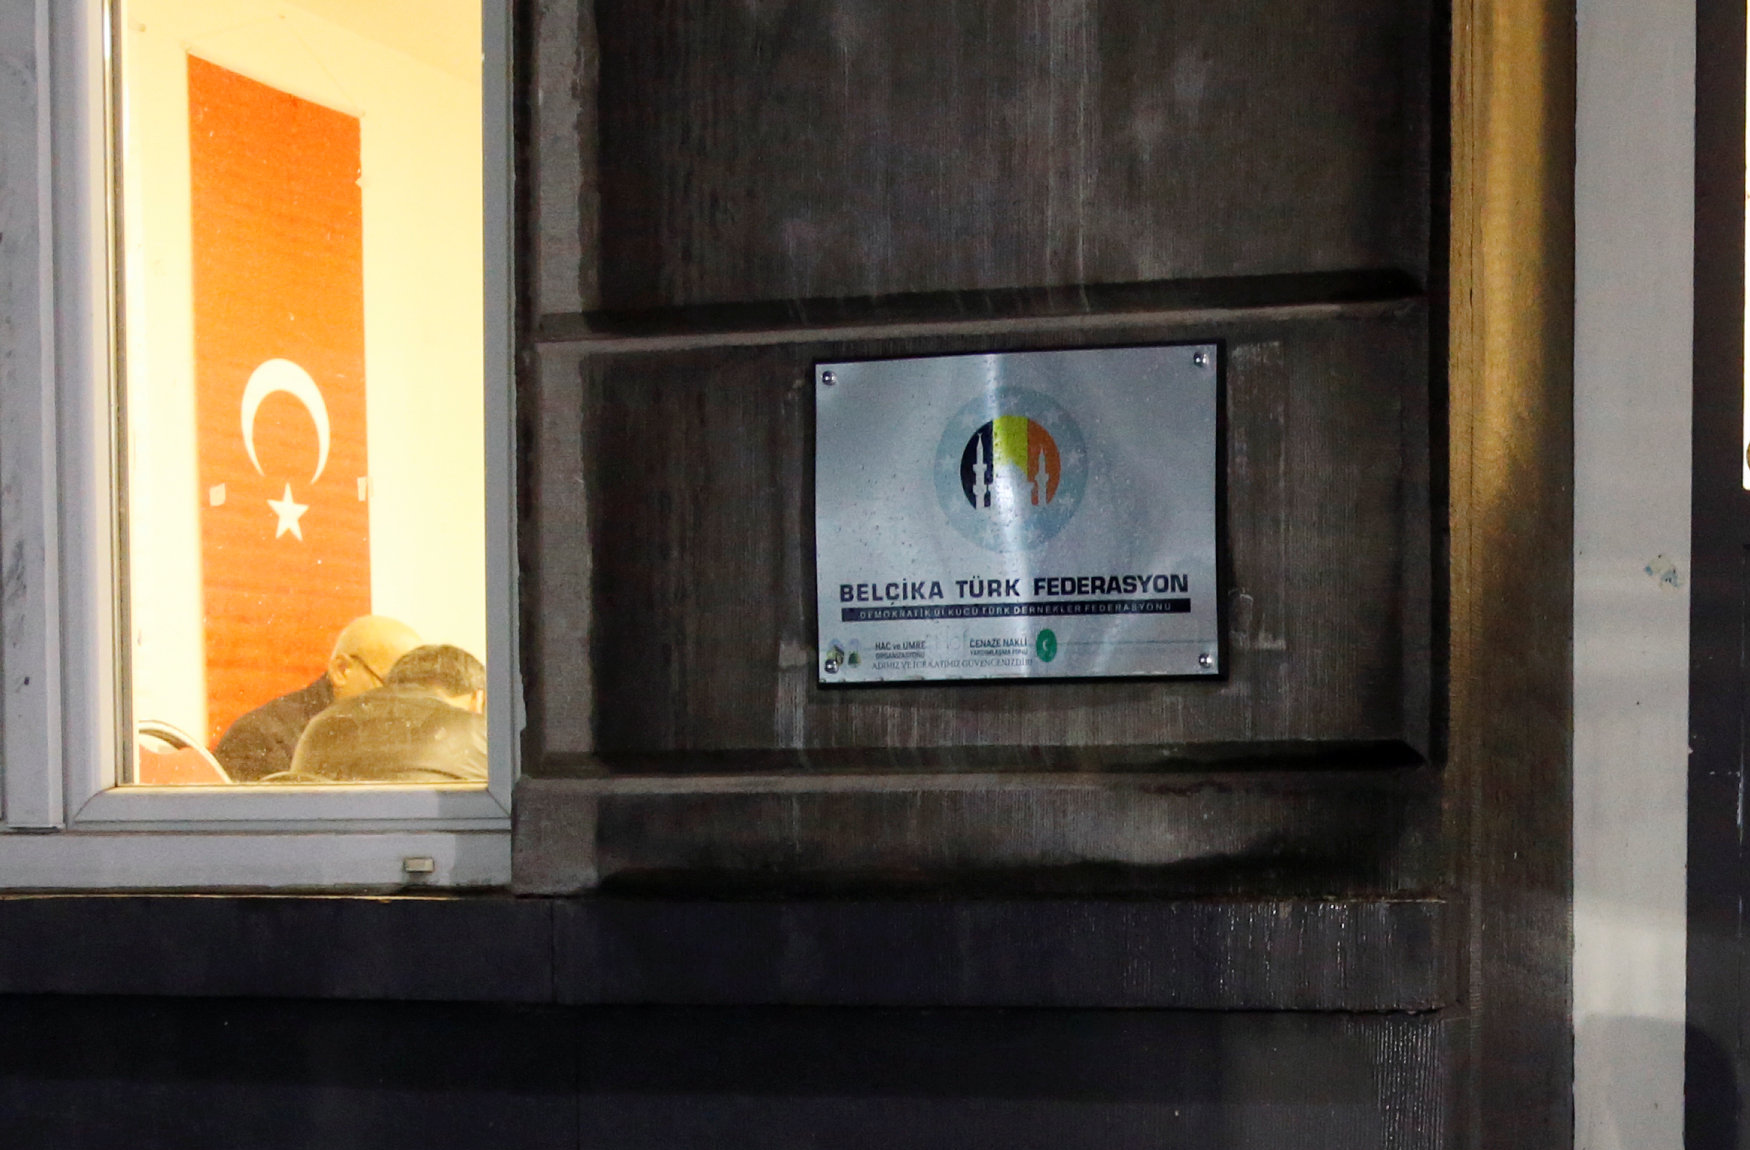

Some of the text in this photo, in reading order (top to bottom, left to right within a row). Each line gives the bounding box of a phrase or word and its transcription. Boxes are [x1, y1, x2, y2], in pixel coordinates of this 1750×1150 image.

[840, 574, 1188, 605] BELÇİKA TÜRK FEDERASYON
[875, 641, 891, 650] HAC
[969, 638, 1001, 648] CENAZE
